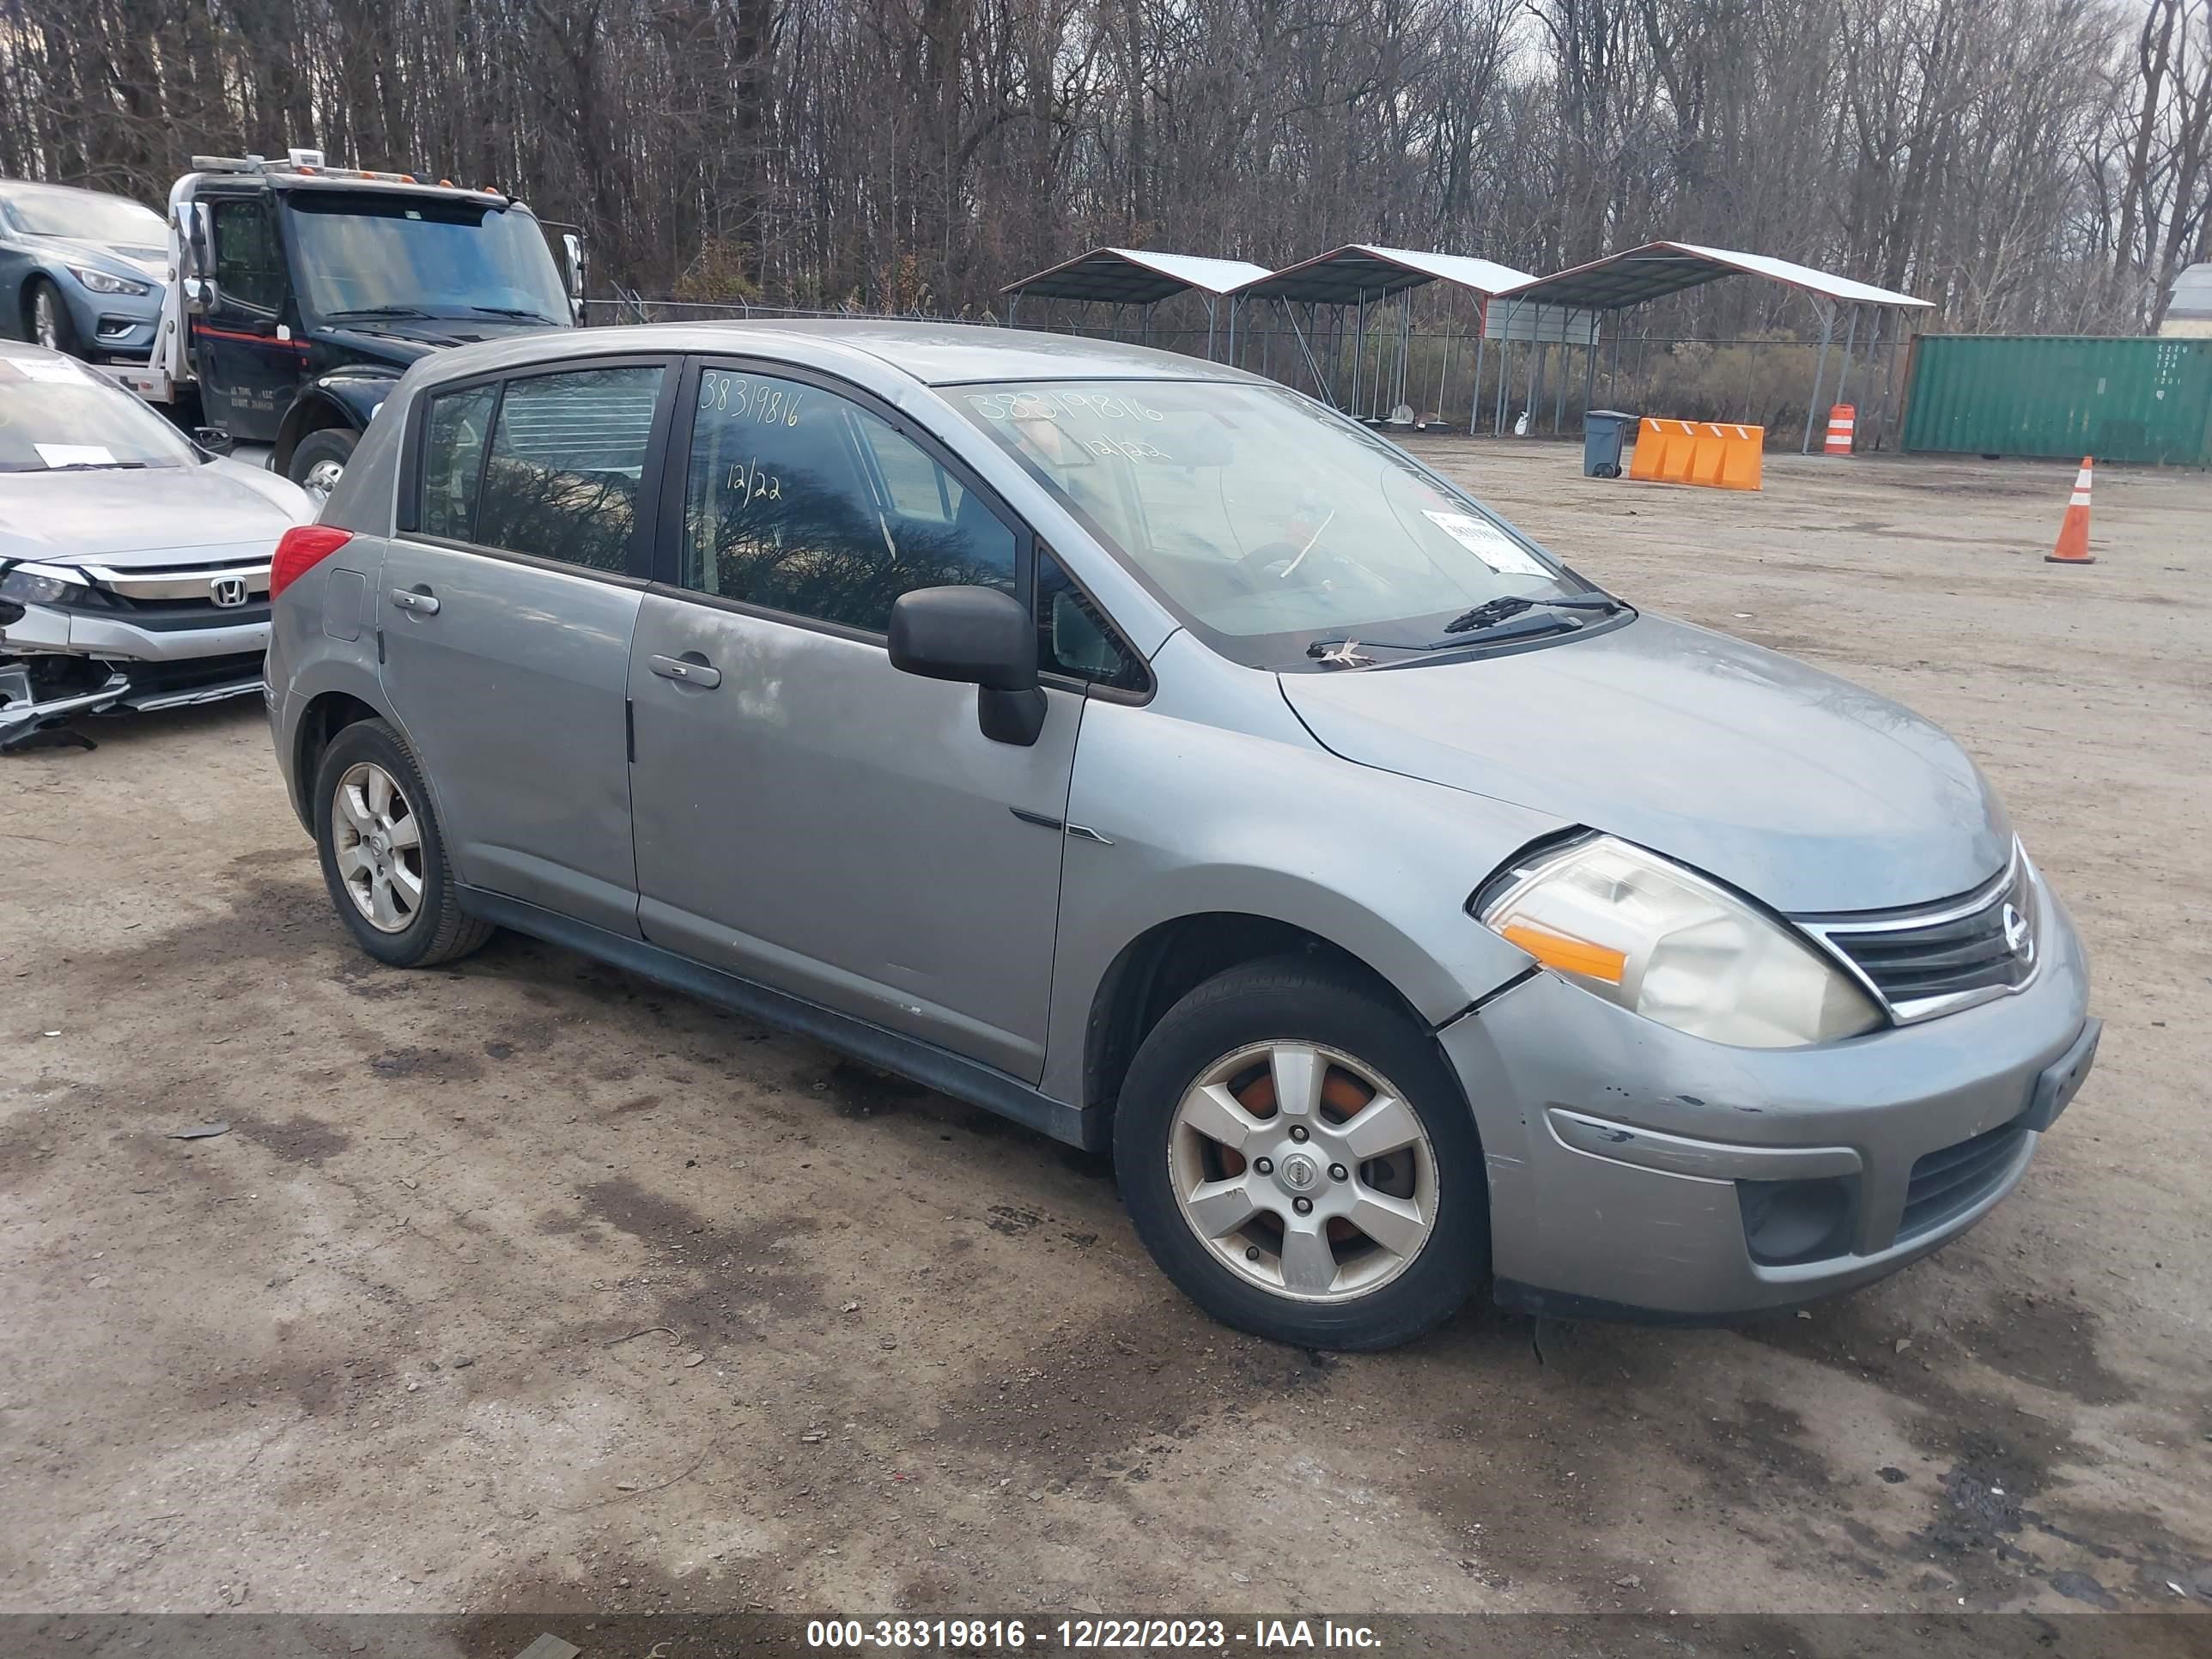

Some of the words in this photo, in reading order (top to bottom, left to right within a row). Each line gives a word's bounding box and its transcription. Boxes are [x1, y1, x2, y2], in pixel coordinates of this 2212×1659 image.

[701, 373, 803, 427] 38319816
[962, 392, 1164, 422] 38319816
[1084, 433, 1173, 465] 12/22
[727, 456, 782, 509] 12/22
